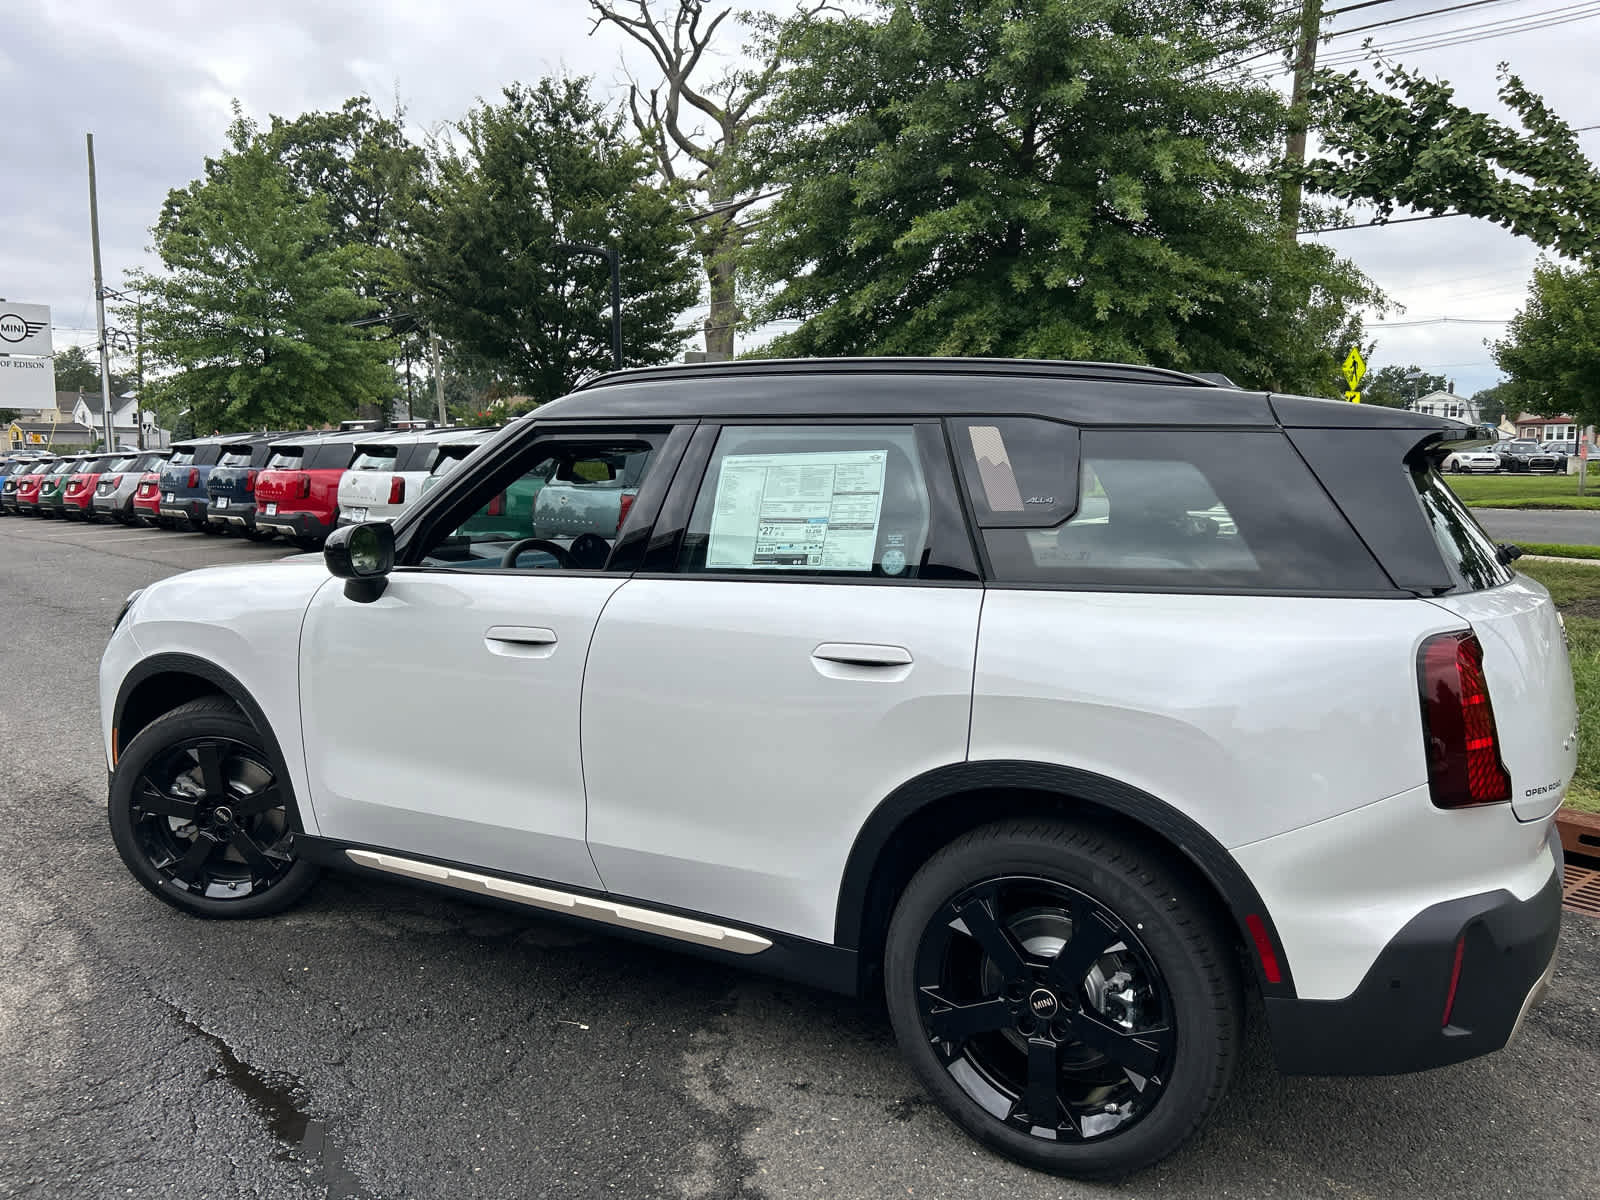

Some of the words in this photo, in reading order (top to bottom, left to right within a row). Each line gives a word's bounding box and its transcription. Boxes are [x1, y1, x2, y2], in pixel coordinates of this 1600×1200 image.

[1, 324, 24, 333] MINI
[14, 361, 45, 369] EDISON
[1525, 786, 1548, 797] OPEN
[1033, 998, 1054, 1010] MINI
